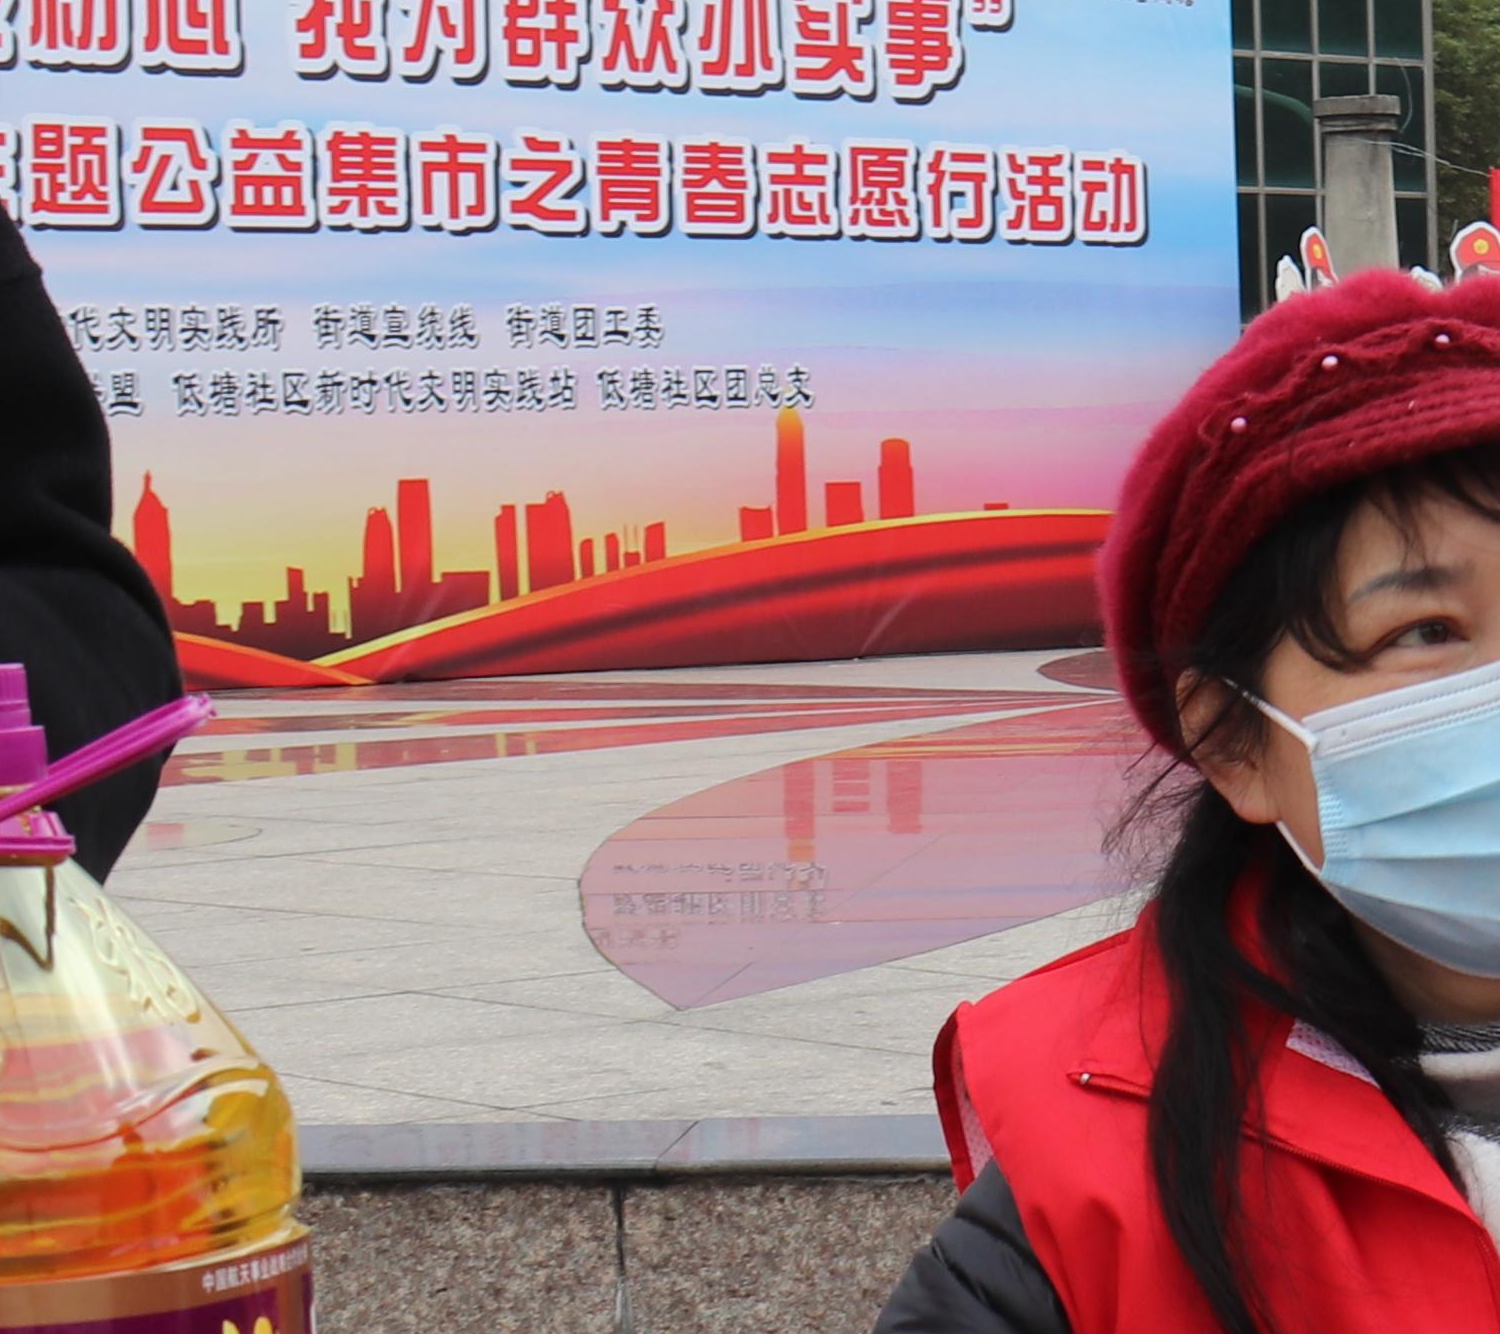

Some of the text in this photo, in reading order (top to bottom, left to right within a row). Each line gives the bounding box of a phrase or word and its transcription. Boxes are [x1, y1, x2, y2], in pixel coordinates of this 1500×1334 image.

[505, 301, 665, 349] 街道团工委
[595, 362, 816, 412] 低塘社区团总支
